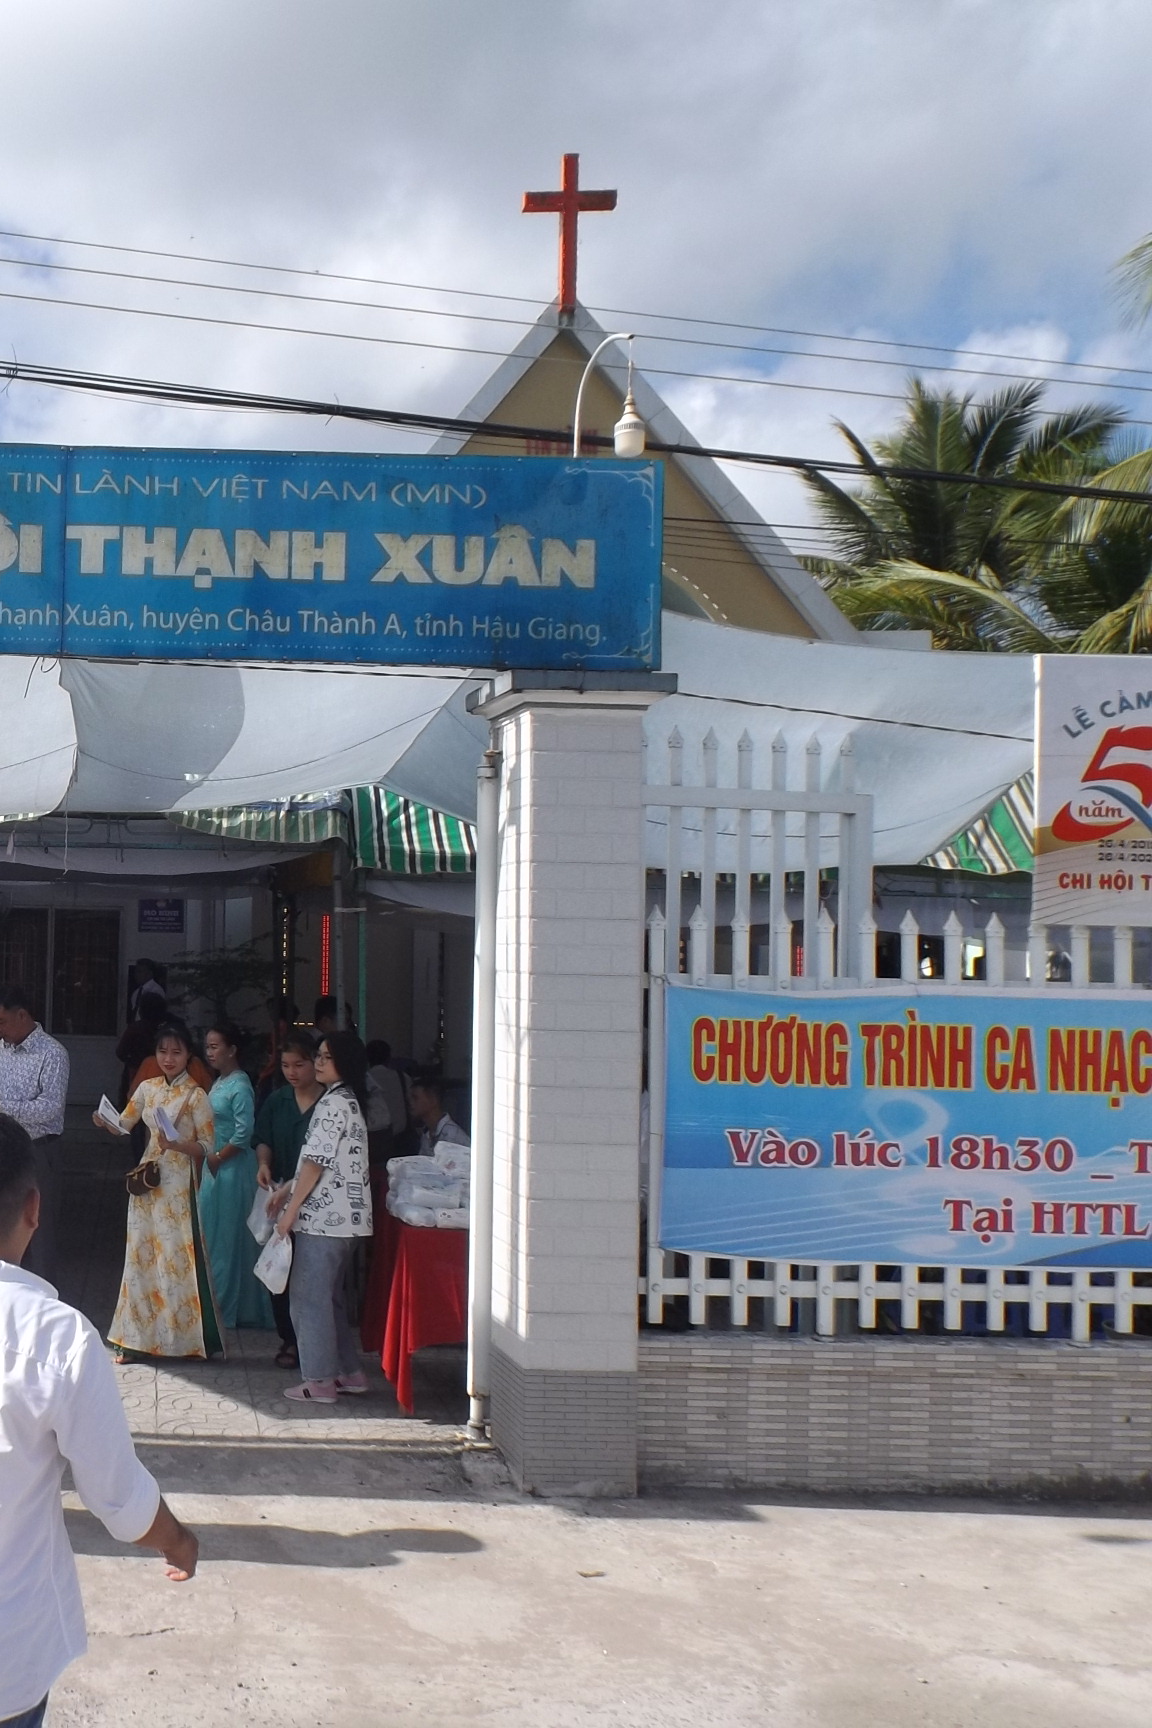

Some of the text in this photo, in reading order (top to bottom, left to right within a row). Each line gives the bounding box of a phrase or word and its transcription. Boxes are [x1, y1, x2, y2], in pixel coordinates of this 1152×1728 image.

[7, 472, 62, 494] TIN
[75, 469, 179, 497] LÀNH
[192, 475, 268, 503] VIỆT
[282, 480, 377, 502] NAM
[391, 483, 487, 508] (MN)
[66, 525, 347, 588] THẠNH
[371, 524, 596, 589] XUÂN
[64, 603, 134, 631] Xuân,
[143, 605, 219, 634] huyện
[227, 608, 291, 632] Châu
[298, 610, 376, 634] Thành
[383, 613, 408, 639] A,
[414, 613, 464, 637] tỉnh
[528, 617, 607, 646] Giang.
[1078, 800, 1124, 819] năm
[1059, 872, 1092, 890] CHI
[1099, 869, 1134, 894] HỘI
[691, 1009, 1152, 1108] CHƯƠNG TRÌNH CA NHẠC
[726, 1129, 818, 1167] Vào
[833, 1129, 902, 1167] lúc
[926, 1135, 1075, 1173] 18h30
[943, 1197, 1150, 1243] Tại HTTL
